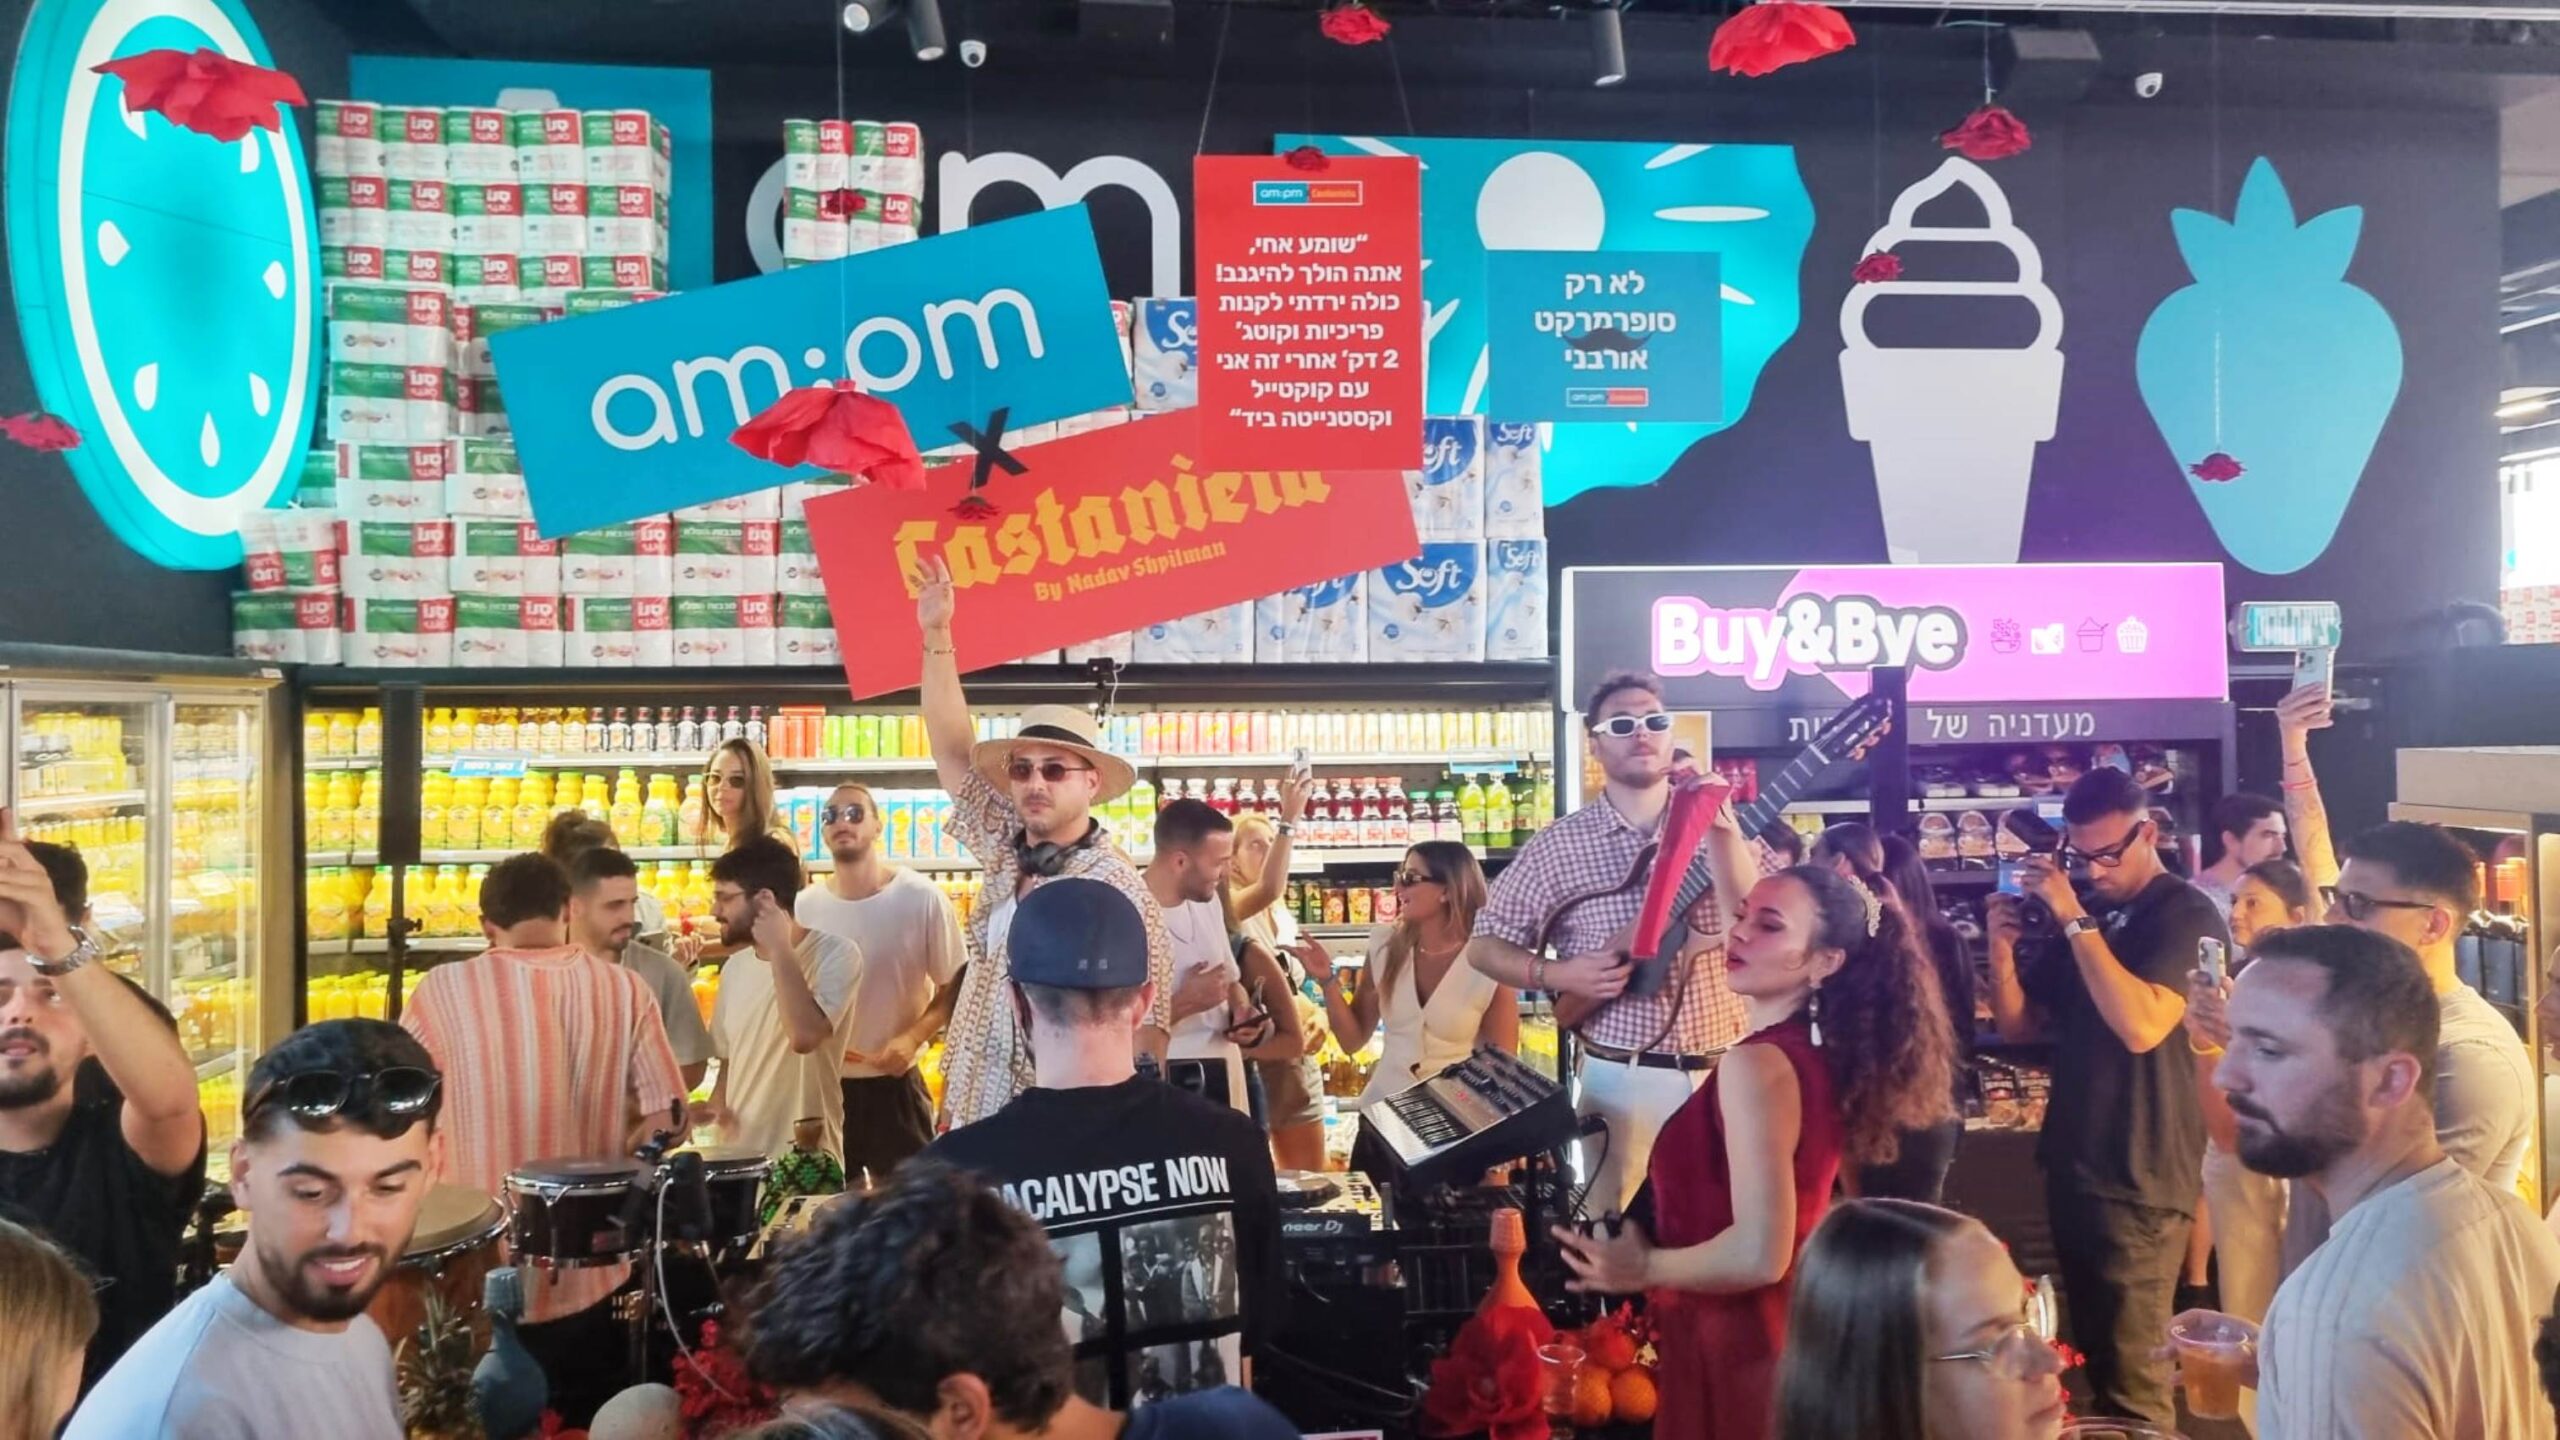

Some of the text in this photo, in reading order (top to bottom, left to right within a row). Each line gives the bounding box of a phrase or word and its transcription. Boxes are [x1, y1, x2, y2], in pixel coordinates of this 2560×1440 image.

[1248, 237, 1293, 255] אחי,
[1215, 263, 1402, 285] אתה הולך להיגנב!
[1565, 270, 1645, 300] לא רק
[1218, 291, 1400, 315] כולה ירדתי לקנות
[1304, 323, 1384, 340] פריכיות
[1534, 311, 1677, 338] סופרמרקט
[1216, 353, 1249, 369] אני
[1255, 354, 1279, 369] זה
[1285, 353, 1336, 369] אחרי
[1383, 349, 1399, 369] 2
[1251, 379, 1369, 402] עם קוקטייל
[1281, 410, 1393, 431] וקסטנייטה
[1033, 540, 1228, 602] By Nadav Shpilman
[1395, 557, 1463, 596] Soft
[1658, 598, 1958, 680] Buy&Bye
[1926, 708, 2096, 738] מעדניה של
[1165, 1156, 1230, 1198] NOW
